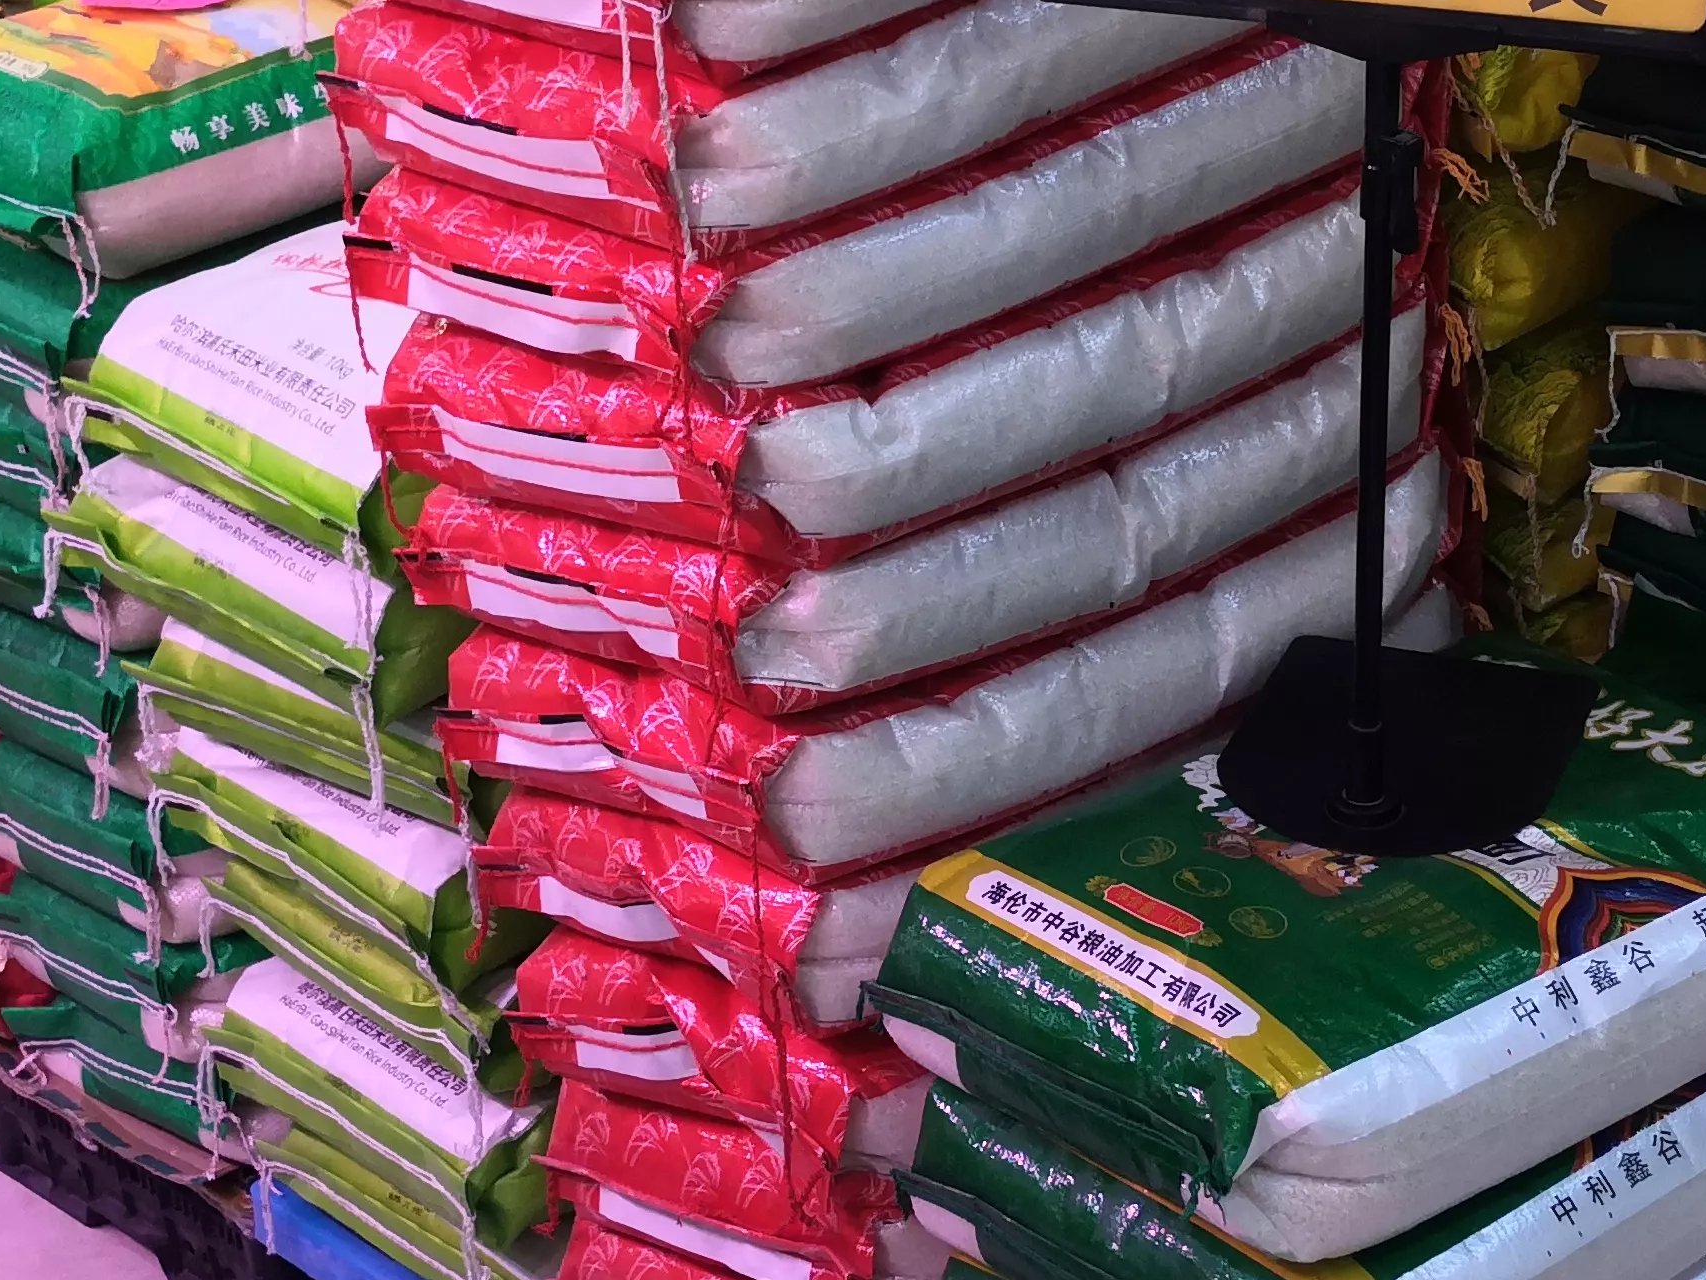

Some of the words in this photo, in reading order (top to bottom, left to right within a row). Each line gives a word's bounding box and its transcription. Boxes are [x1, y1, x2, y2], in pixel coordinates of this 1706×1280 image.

[982, 880, 1242, 1028] 海伦市中谷粮油加工有限公司
[1511, 941, 1655, 1026] 中利鑫谷
[1550, 1130, 1683, 1226] 中利鑫谷
